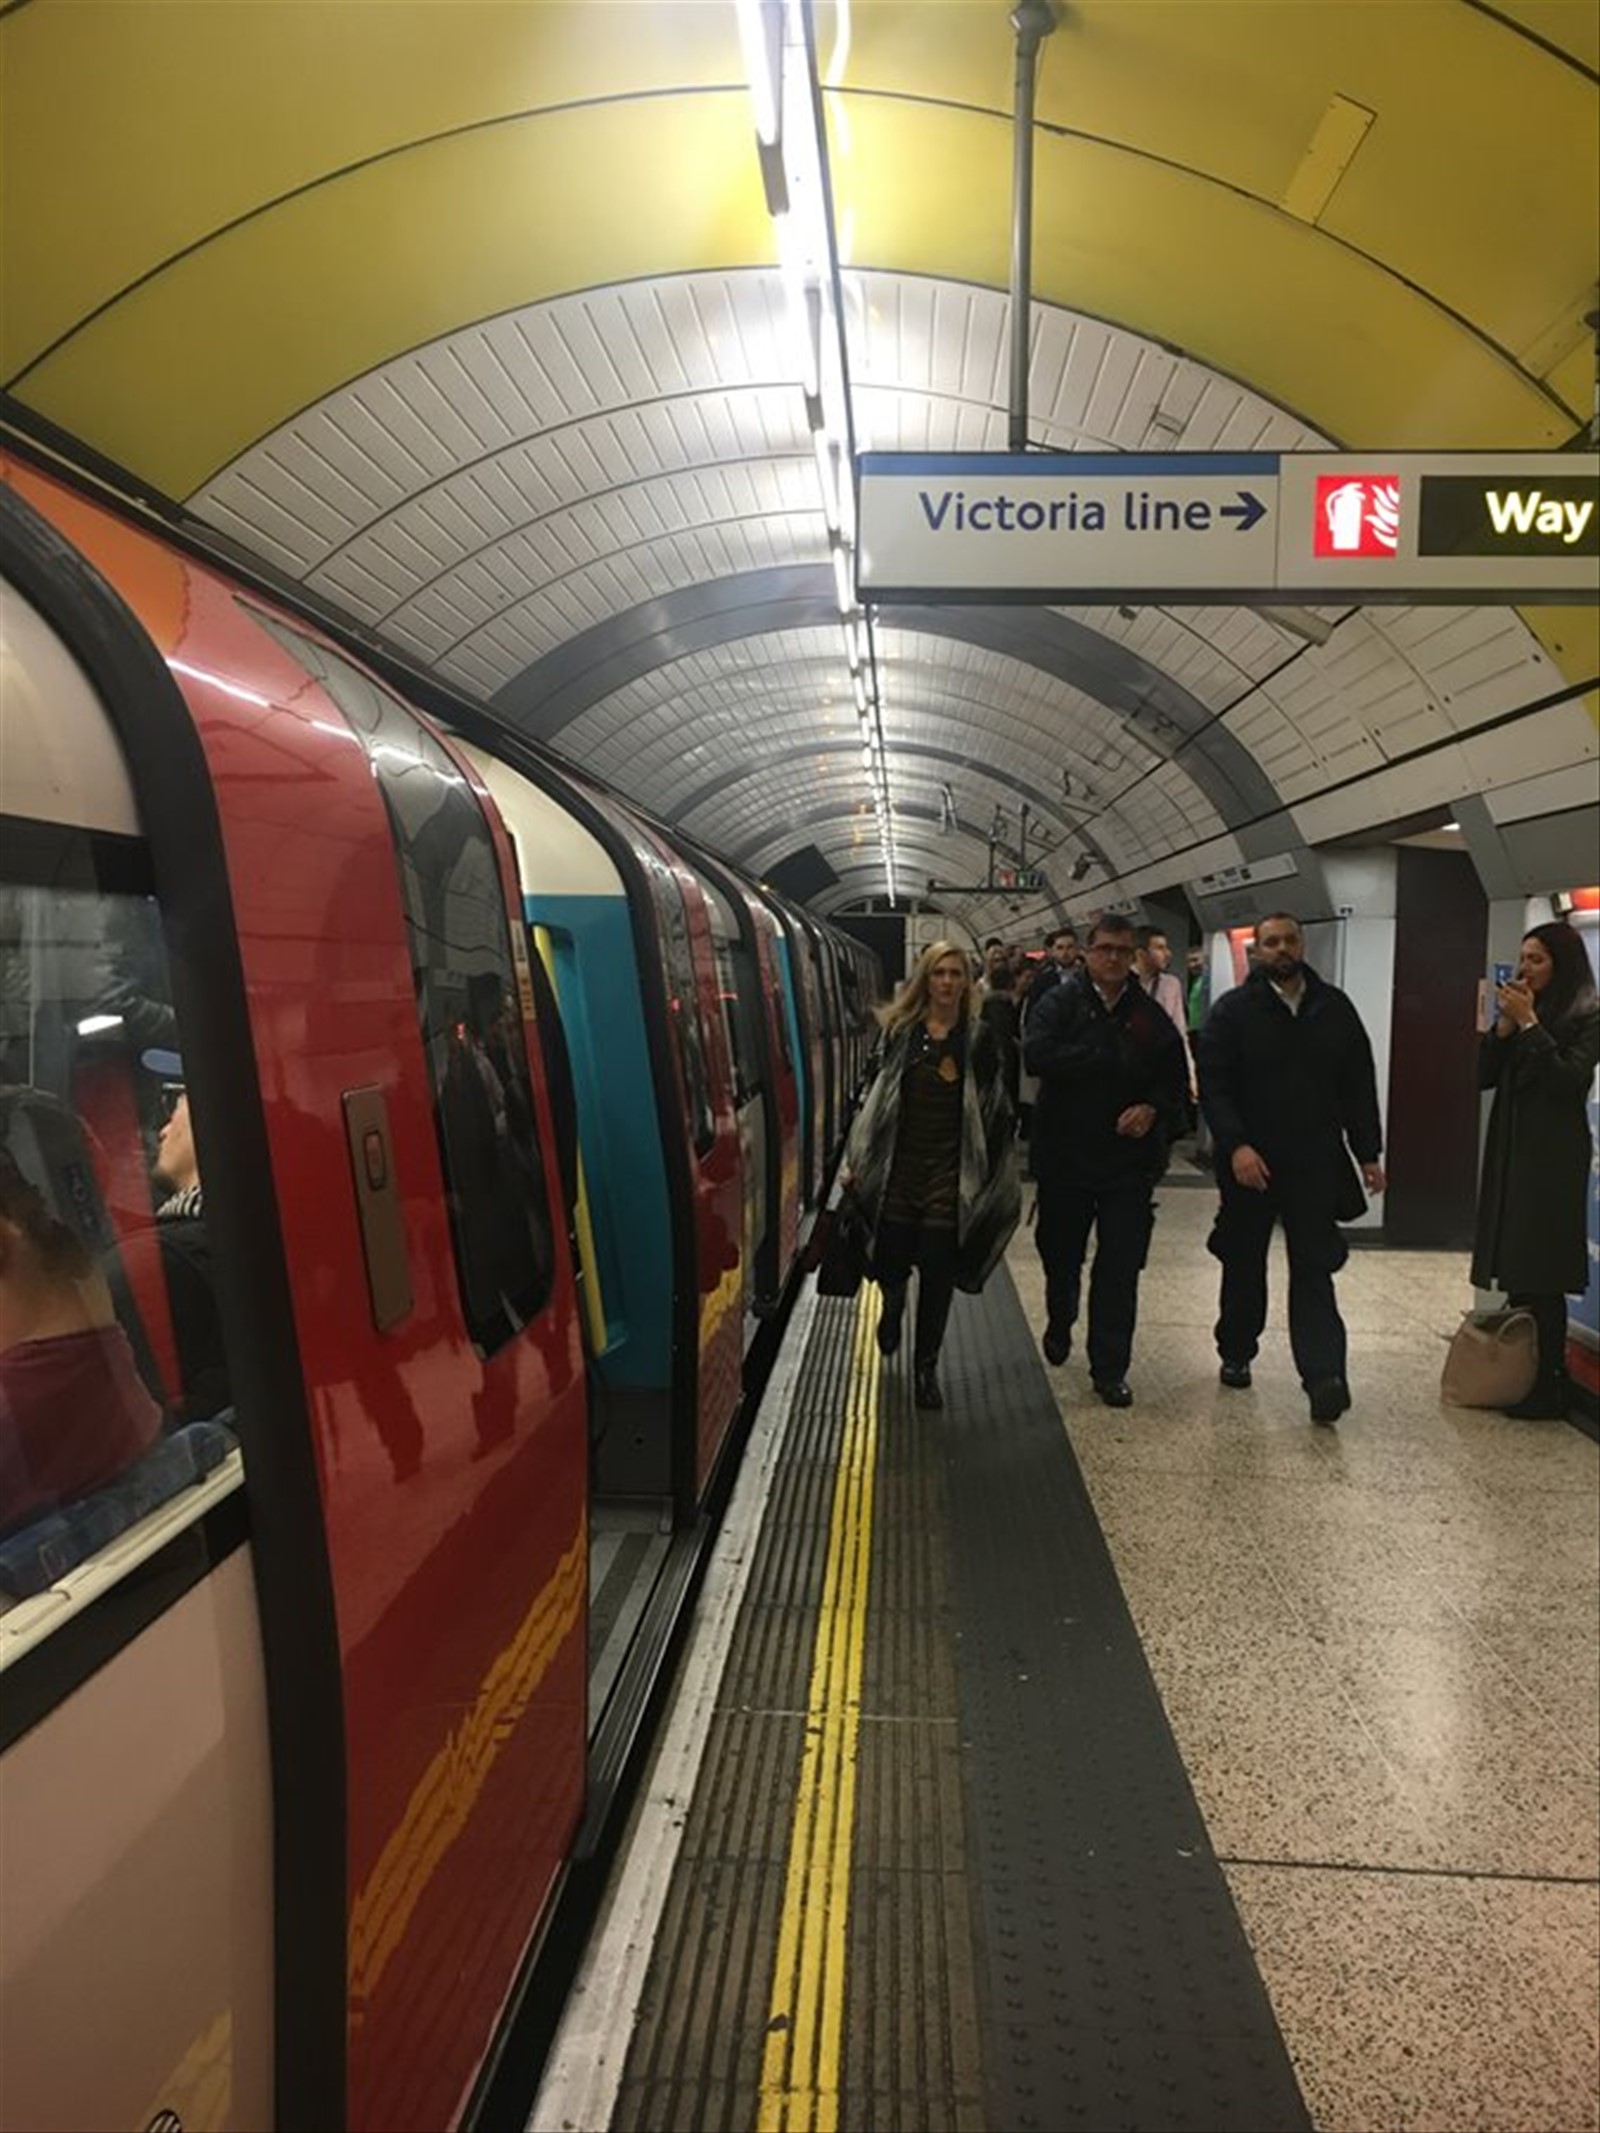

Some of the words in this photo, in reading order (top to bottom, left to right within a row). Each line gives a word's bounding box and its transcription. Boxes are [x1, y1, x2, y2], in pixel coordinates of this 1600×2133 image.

[919, 491, 1105, 531] Victoria
[1124, 491, 1211, 531] line
[1485, 491, 1594, 543] Way
